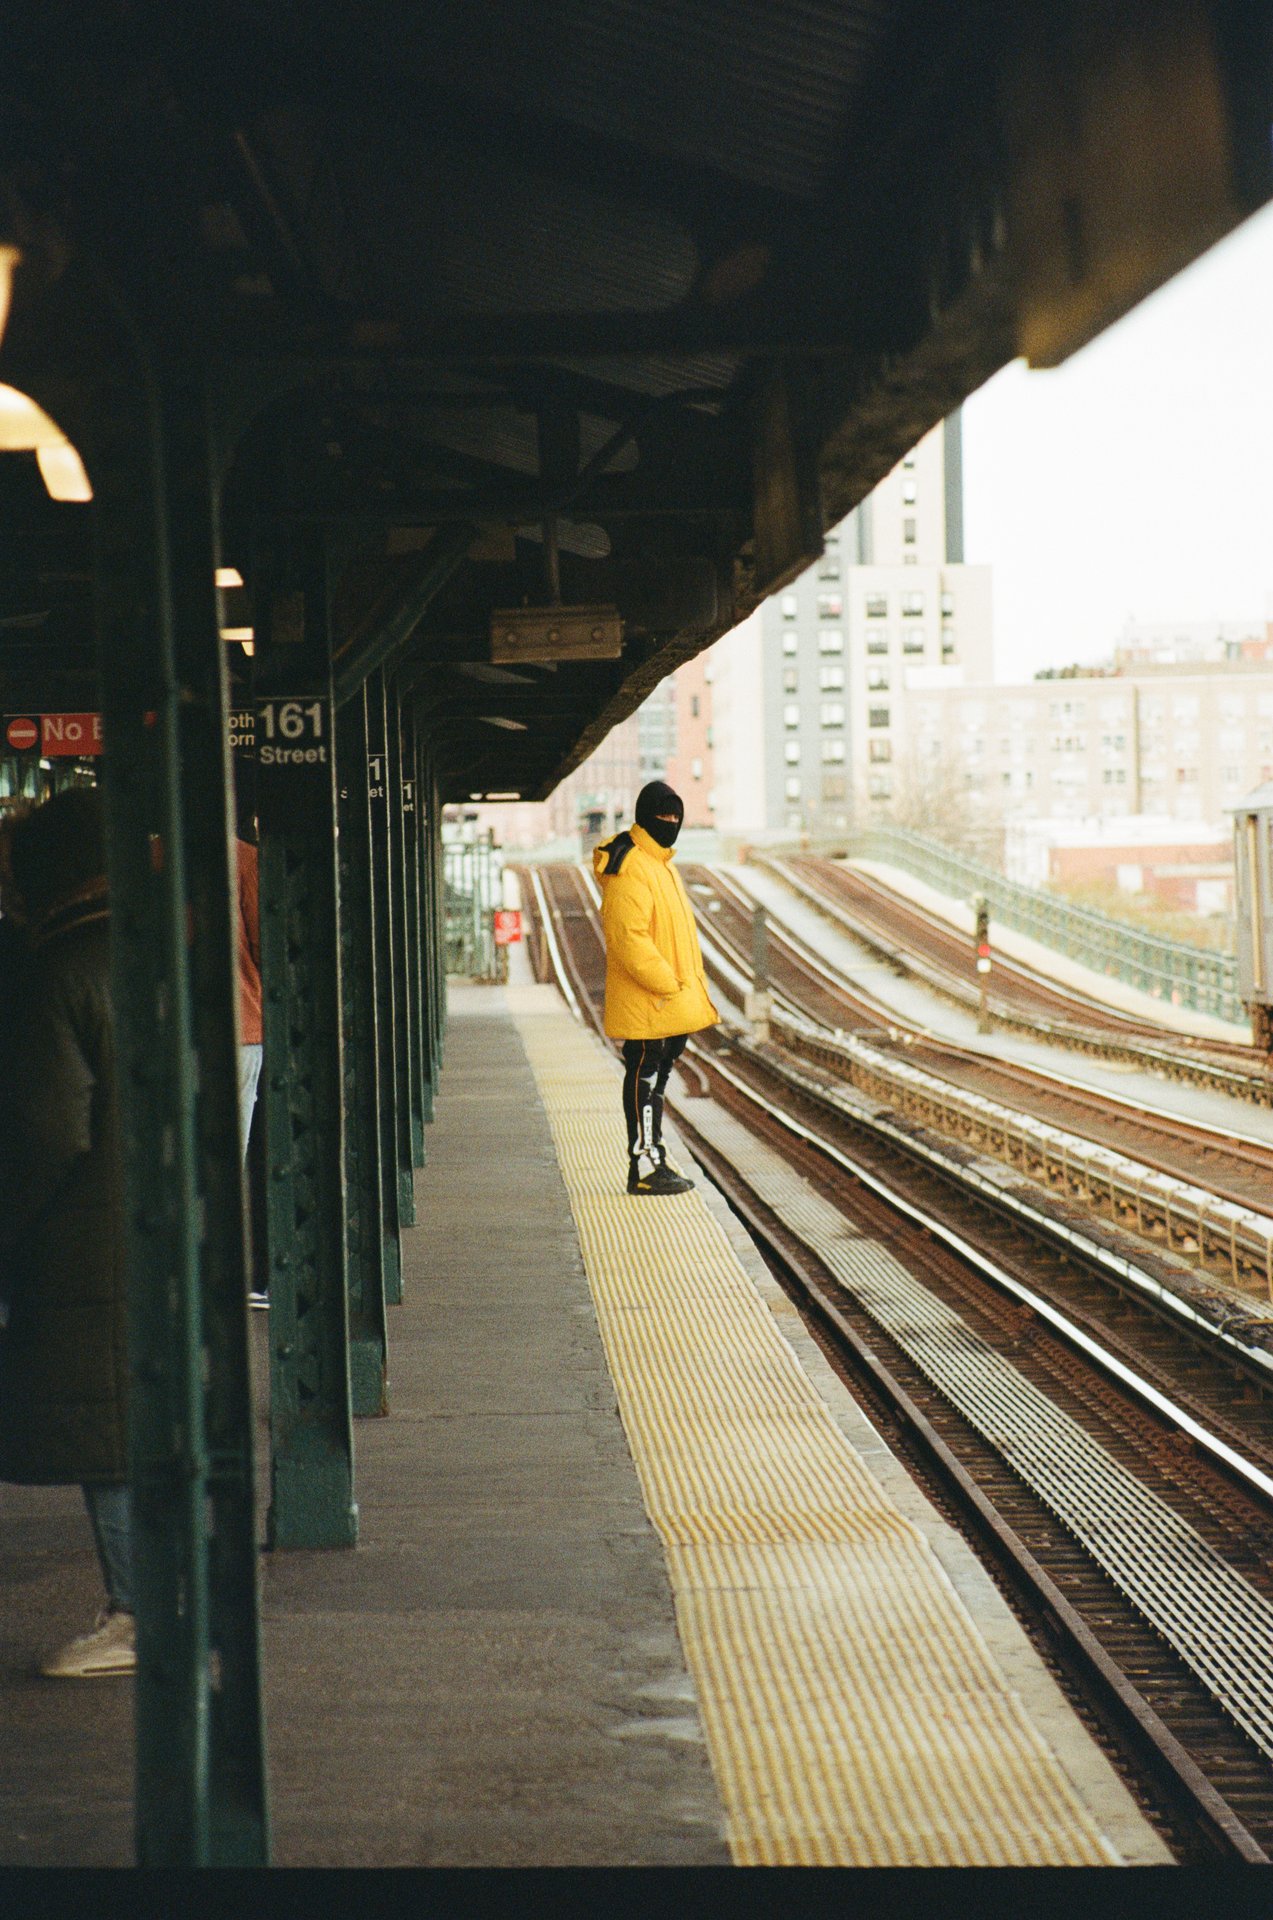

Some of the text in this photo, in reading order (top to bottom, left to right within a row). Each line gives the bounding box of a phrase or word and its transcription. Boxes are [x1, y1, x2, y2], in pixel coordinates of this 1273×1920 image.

[43, 718, 83, 741] No
[258, 702, 322, 738] 161
[259, 745, 327, 765] Street
